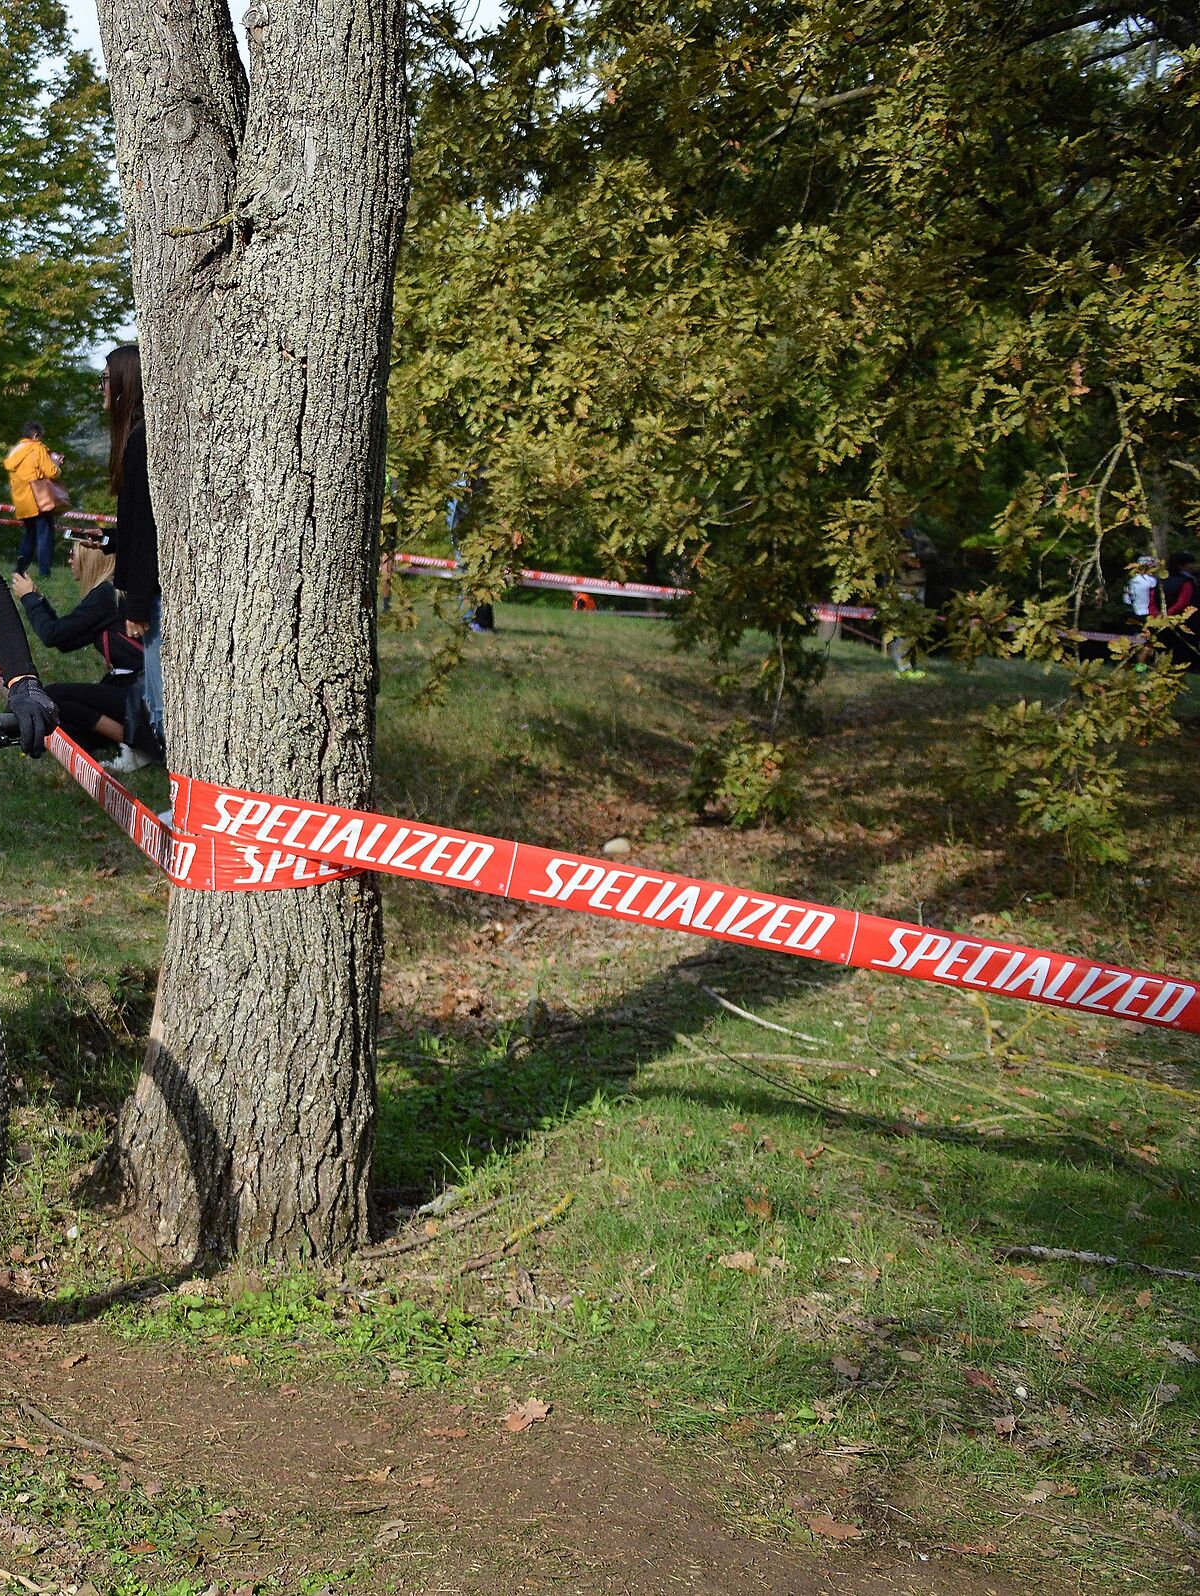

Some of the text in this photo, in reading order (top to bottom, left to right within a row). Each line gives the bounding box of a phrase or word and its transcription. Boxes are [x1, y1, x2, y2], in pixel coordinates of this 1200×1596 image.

[202, 793, 495, 882] SPECIALIZED
[528, 857, 837, 951] SPECIALIZED
[871, 927, 1196, 1022] SPECIALIZED
